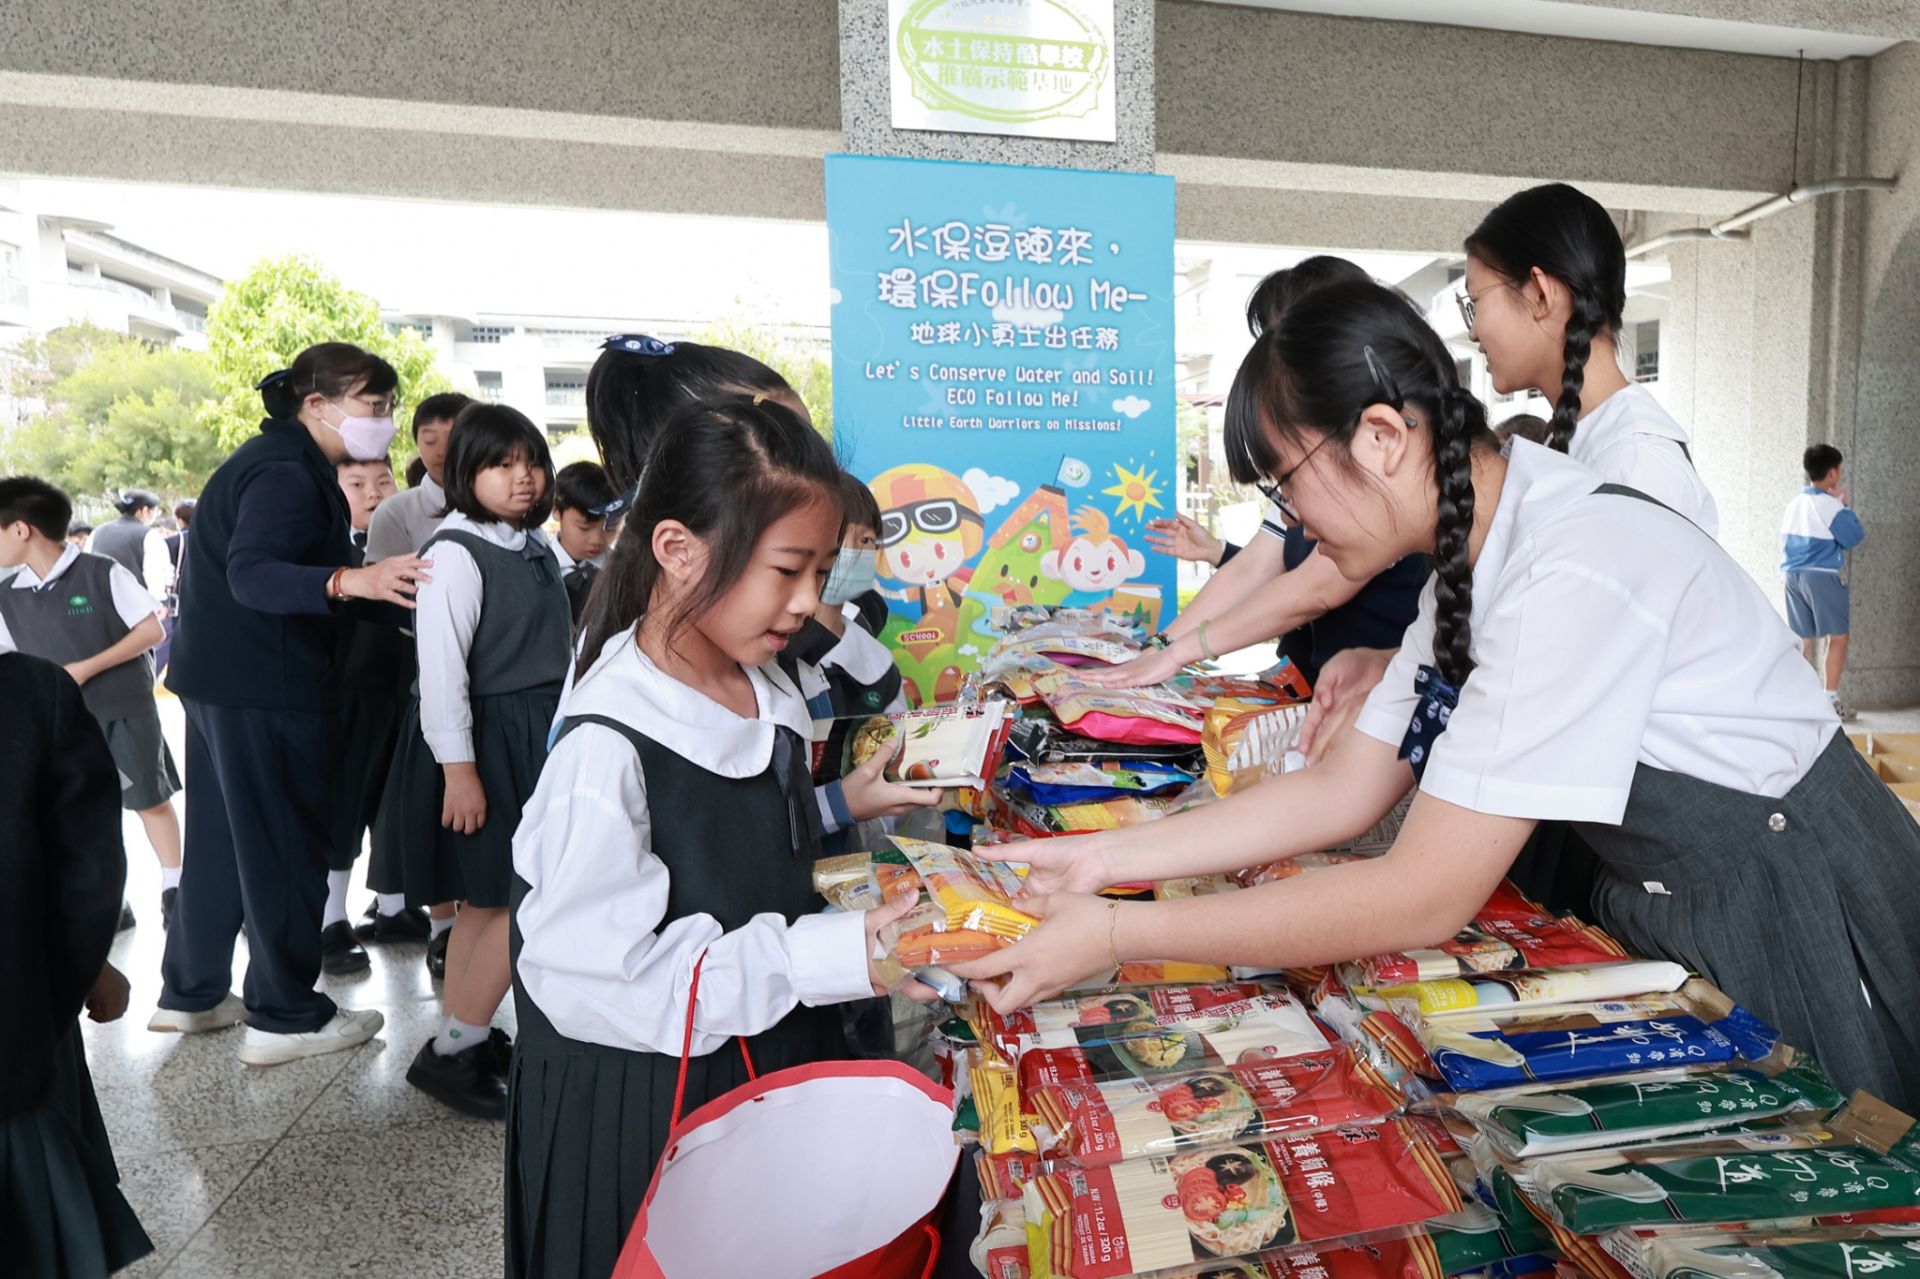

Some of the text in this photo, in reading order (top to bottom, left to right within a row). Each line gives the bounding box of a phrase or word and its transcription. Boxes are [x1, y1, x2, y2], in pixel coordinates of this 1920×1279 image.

[910, 322, 1119, 351] 地球小勇士出任務
[930, 364, 1006, 382] Conserve
[1016, 367, 1062, 383] Water
[1073, 368, 1100, 384] and
[1109, 369, 1153, 385] Soil!
[947, 389, 1078, 407] ECO Follow Me!
[904, 416, 1121, 431] Little Earth Warriors on Missions!
[1100, 1236, 1111, 1253] 320
[1100, 1254, 1112, 1262] g
